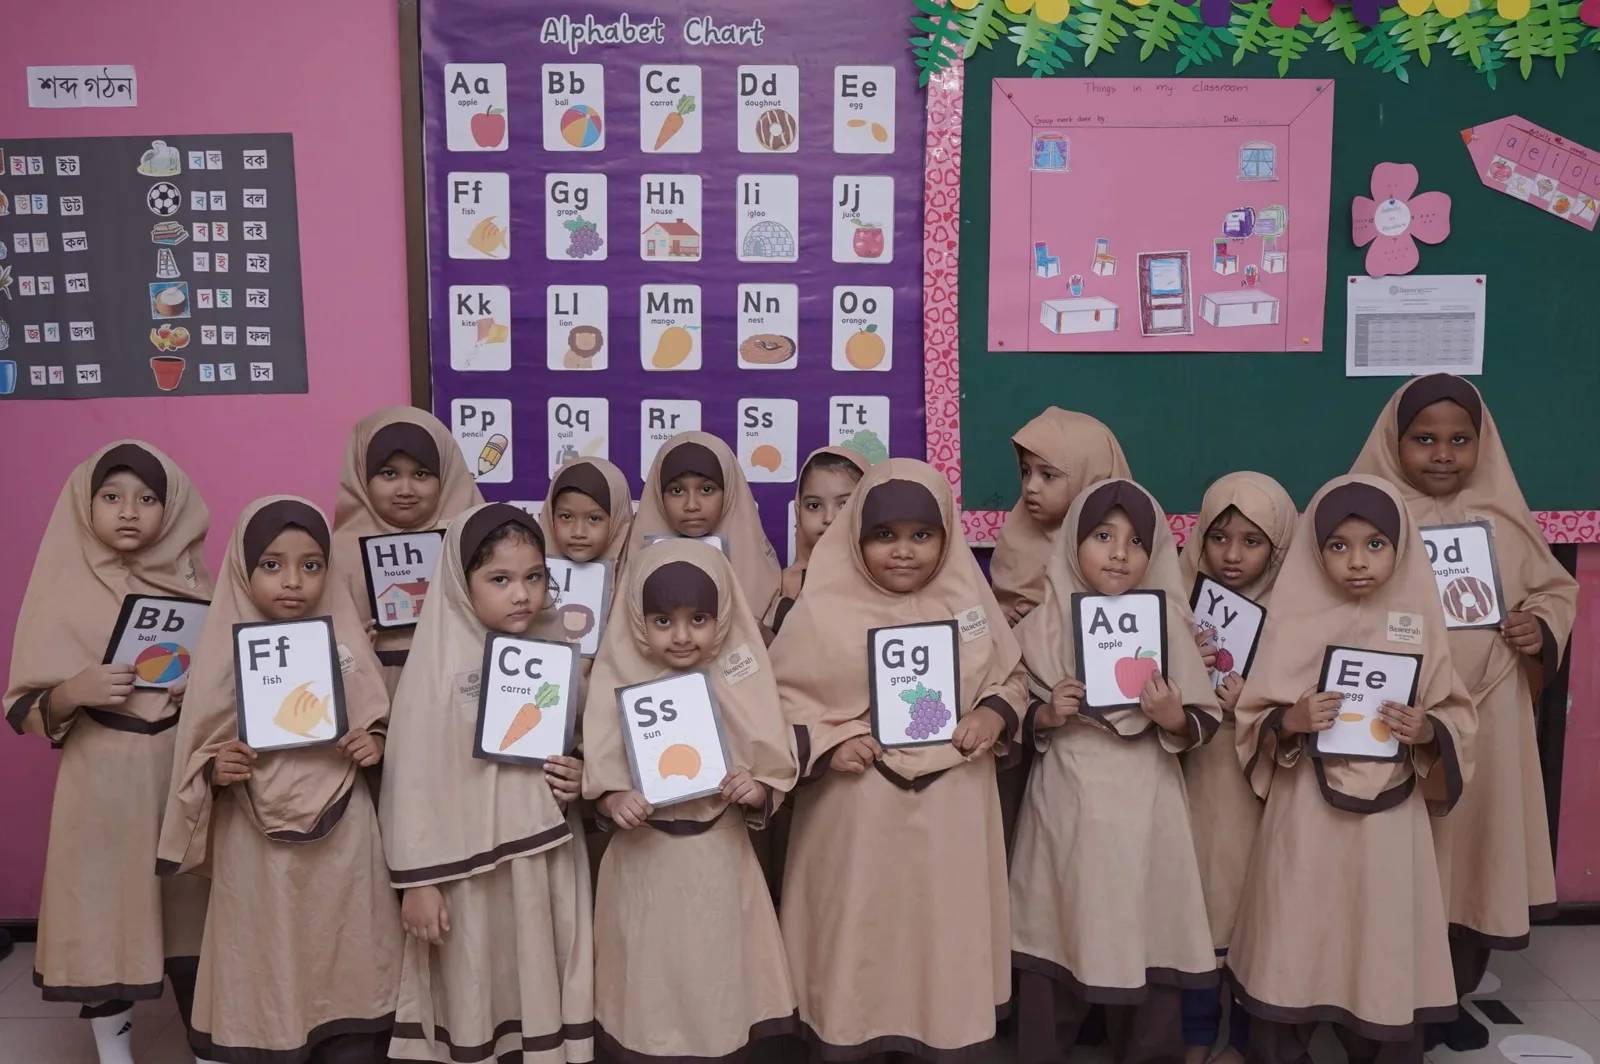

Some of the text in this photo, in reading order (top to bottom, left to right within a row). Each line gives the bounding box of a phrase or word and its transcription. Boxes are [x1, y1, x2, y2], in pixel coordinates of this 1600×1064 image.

[540, 14, 765, 55] Alphabet Chart
[37, 67, 133, 100] শব্দ গঠন
[450, 72, 490, 94] Aa
[548, 71, 584, 94] Bb
[646, 70, 680, 93] Cc
[741, 73, 776, 96] Dd
[842, 75, 877, 97] Ee
[1084, 80, 1248, 96] Things in my classroom
[745, 100, 780, 108] doughnut
[1034, 115, 1054, 125] Group
[13, 158, 76, 174] ই ট ইট
[192, 154, 264, 167] ব ক বক
[1506, 137, 1518, 150] a
[1528, 147, 1540, 161] e
[1551, 153, 1560, 169] i
[1571, 165, 1583, 178] o
[195, 194, 264, 207] ব ল বল
[454, 181, 482, 203] Ff
[551, 181, 588, 211] Gg
[646, 182, 684, 204] Hh
[839, 184, 859, 211] Jj
[17, 196, 81, 212] উ ট উট
[748, 210, 765, 218] igloo
[843, 211, 860, 220] juice
[197, 223, 264, 239] ব ই বই
[16, 237, 86, 249] ক ল কল
[196, 255, 267, 271] ম ই মই
[22, 278, 86, 292] গ ম গম
[201, 290, 267, 306] দ ই দই
[457, 293, 491, 315] Kk
[555, 293, 578, 315] Ll
[647, 292, 693, 314] Mm
[743, 291, 779, 313] Nn
[840, 292, 876, 314] Oo
[27, 326, 93, 340] জ গ জগ
[203, 330, 270, 342] ফ ল ফল
[32, 370, 98, 381] ম গ মগ
[204, 365, 270, 379] ট ব টব
[460, 405, 495, 430] Pp
[555, 404, 589, 431] Qq
[649, 408, 680, 429] Rr
[744, 406, 773, 428] Ss
[837, 403, 867, 425] Tt
[462, 430, 484, 438] pencil
[558, 431, 573, 439] quill
[374, 543, 423, 567] Hh
[132, 605, 184, 632] Bb
[1207, 588, 1239, 630] Yy
[1089, 607, 1139, 635] Aa
[248, 636, 290, 671] Ff
[1098, 640, 1122, 649] apple
[499, 646, 543, 679] Cc
[724, 656, 753, 676] Baseerah
[882, 639, 929, 677] Gg
[263, 675, 281, 685] fish
[891, 676, 916, 686] grape
[1336, 660, 1386, 689] Ee
[501, 686, 530, 695] carrot
[1346, 692, 1364, 702] egg
[634, 696, 677, 727] Ss
[644, 731, 661, 739] sun
